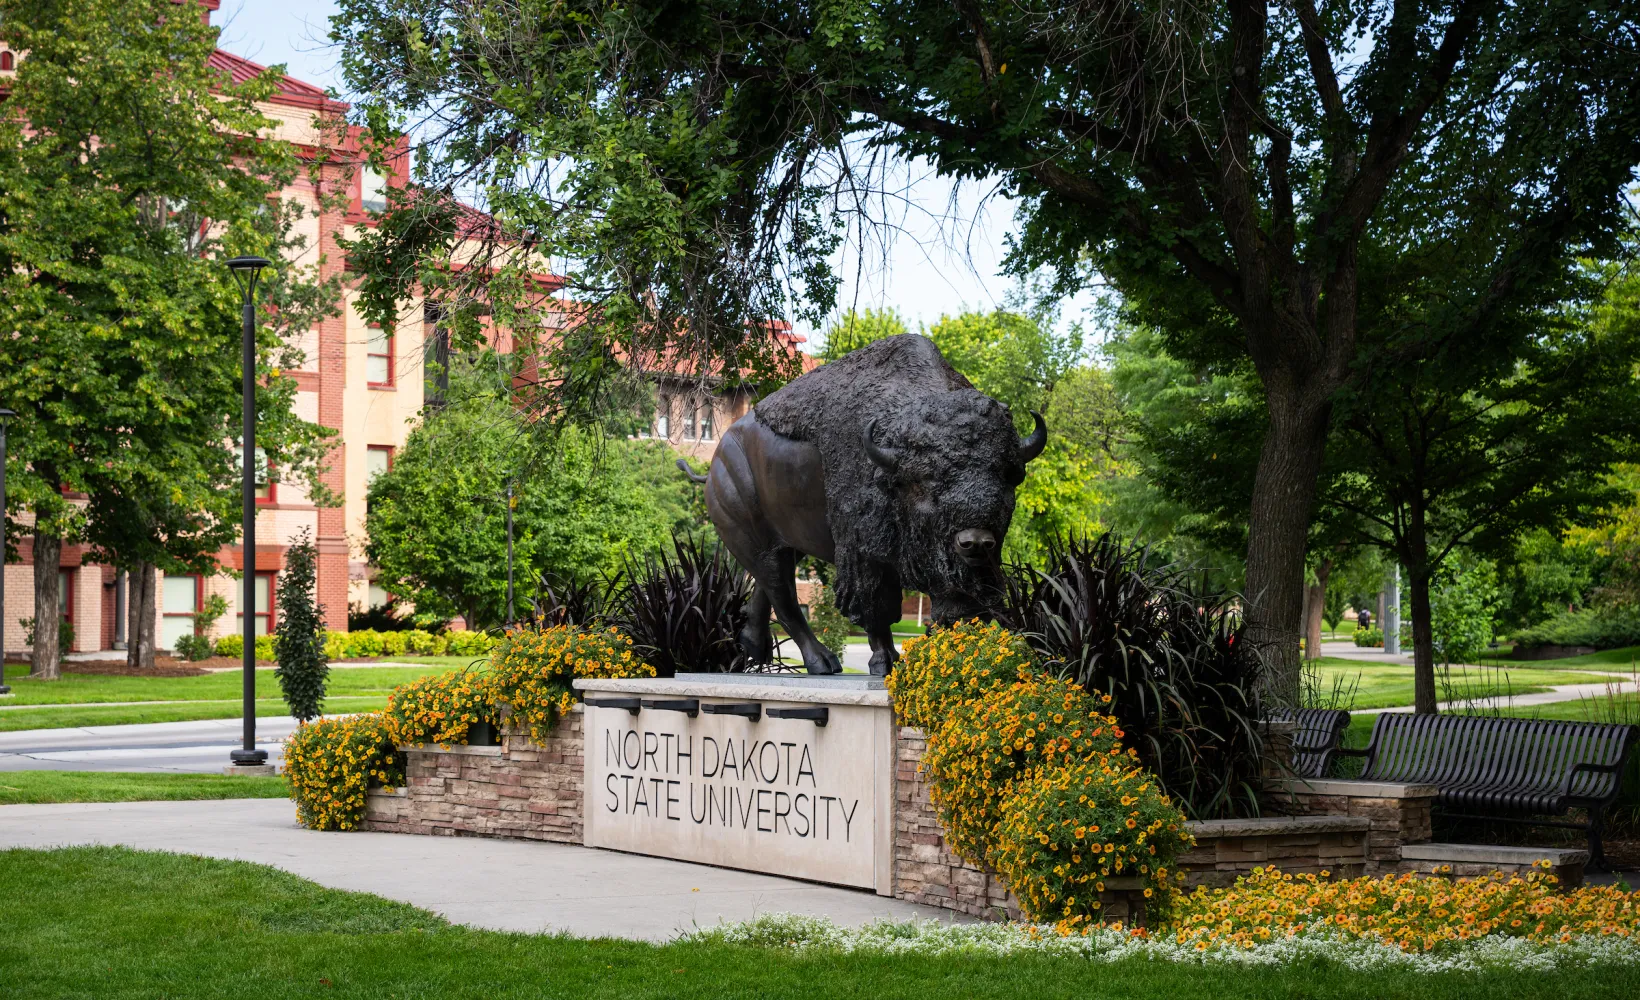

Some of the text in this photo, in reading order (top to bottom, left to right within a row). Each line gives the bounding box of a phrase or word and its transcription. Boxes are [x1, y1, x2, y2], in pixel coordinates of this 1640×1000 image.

[606, 729, 817, 788] NORTH DAKOTA
[605, 773, 859, 843] STATE UNIVERSITY
